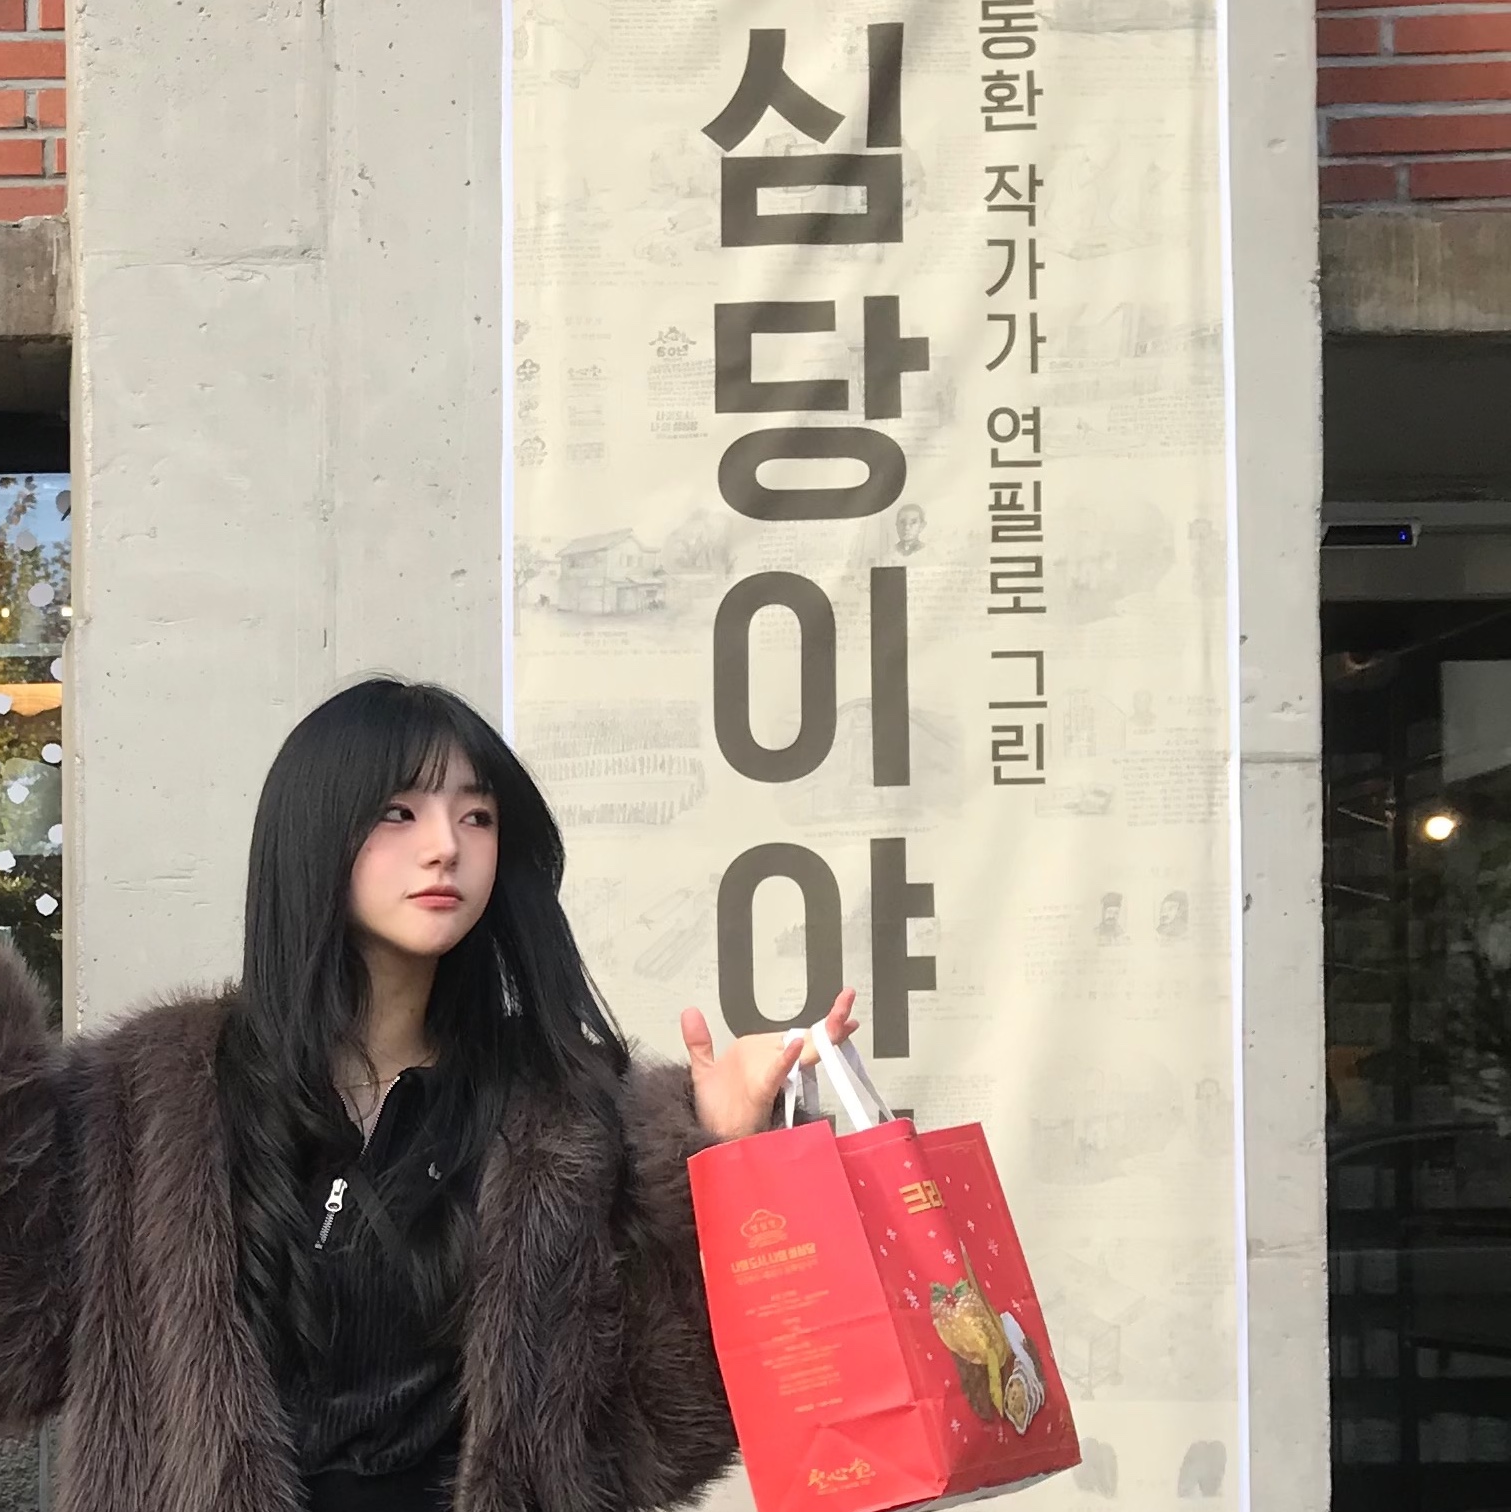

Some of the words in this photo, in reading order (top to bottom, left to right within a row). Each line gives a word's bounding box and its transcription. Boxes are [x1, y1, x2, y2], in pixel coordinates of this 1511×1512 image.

[983, 163, 1046, 375] 작가가
[701, 22, 937, 1120] 심당이야
[986, 405, 1048, 616] 연필로
[988, 650, 1048, 786] 그린
